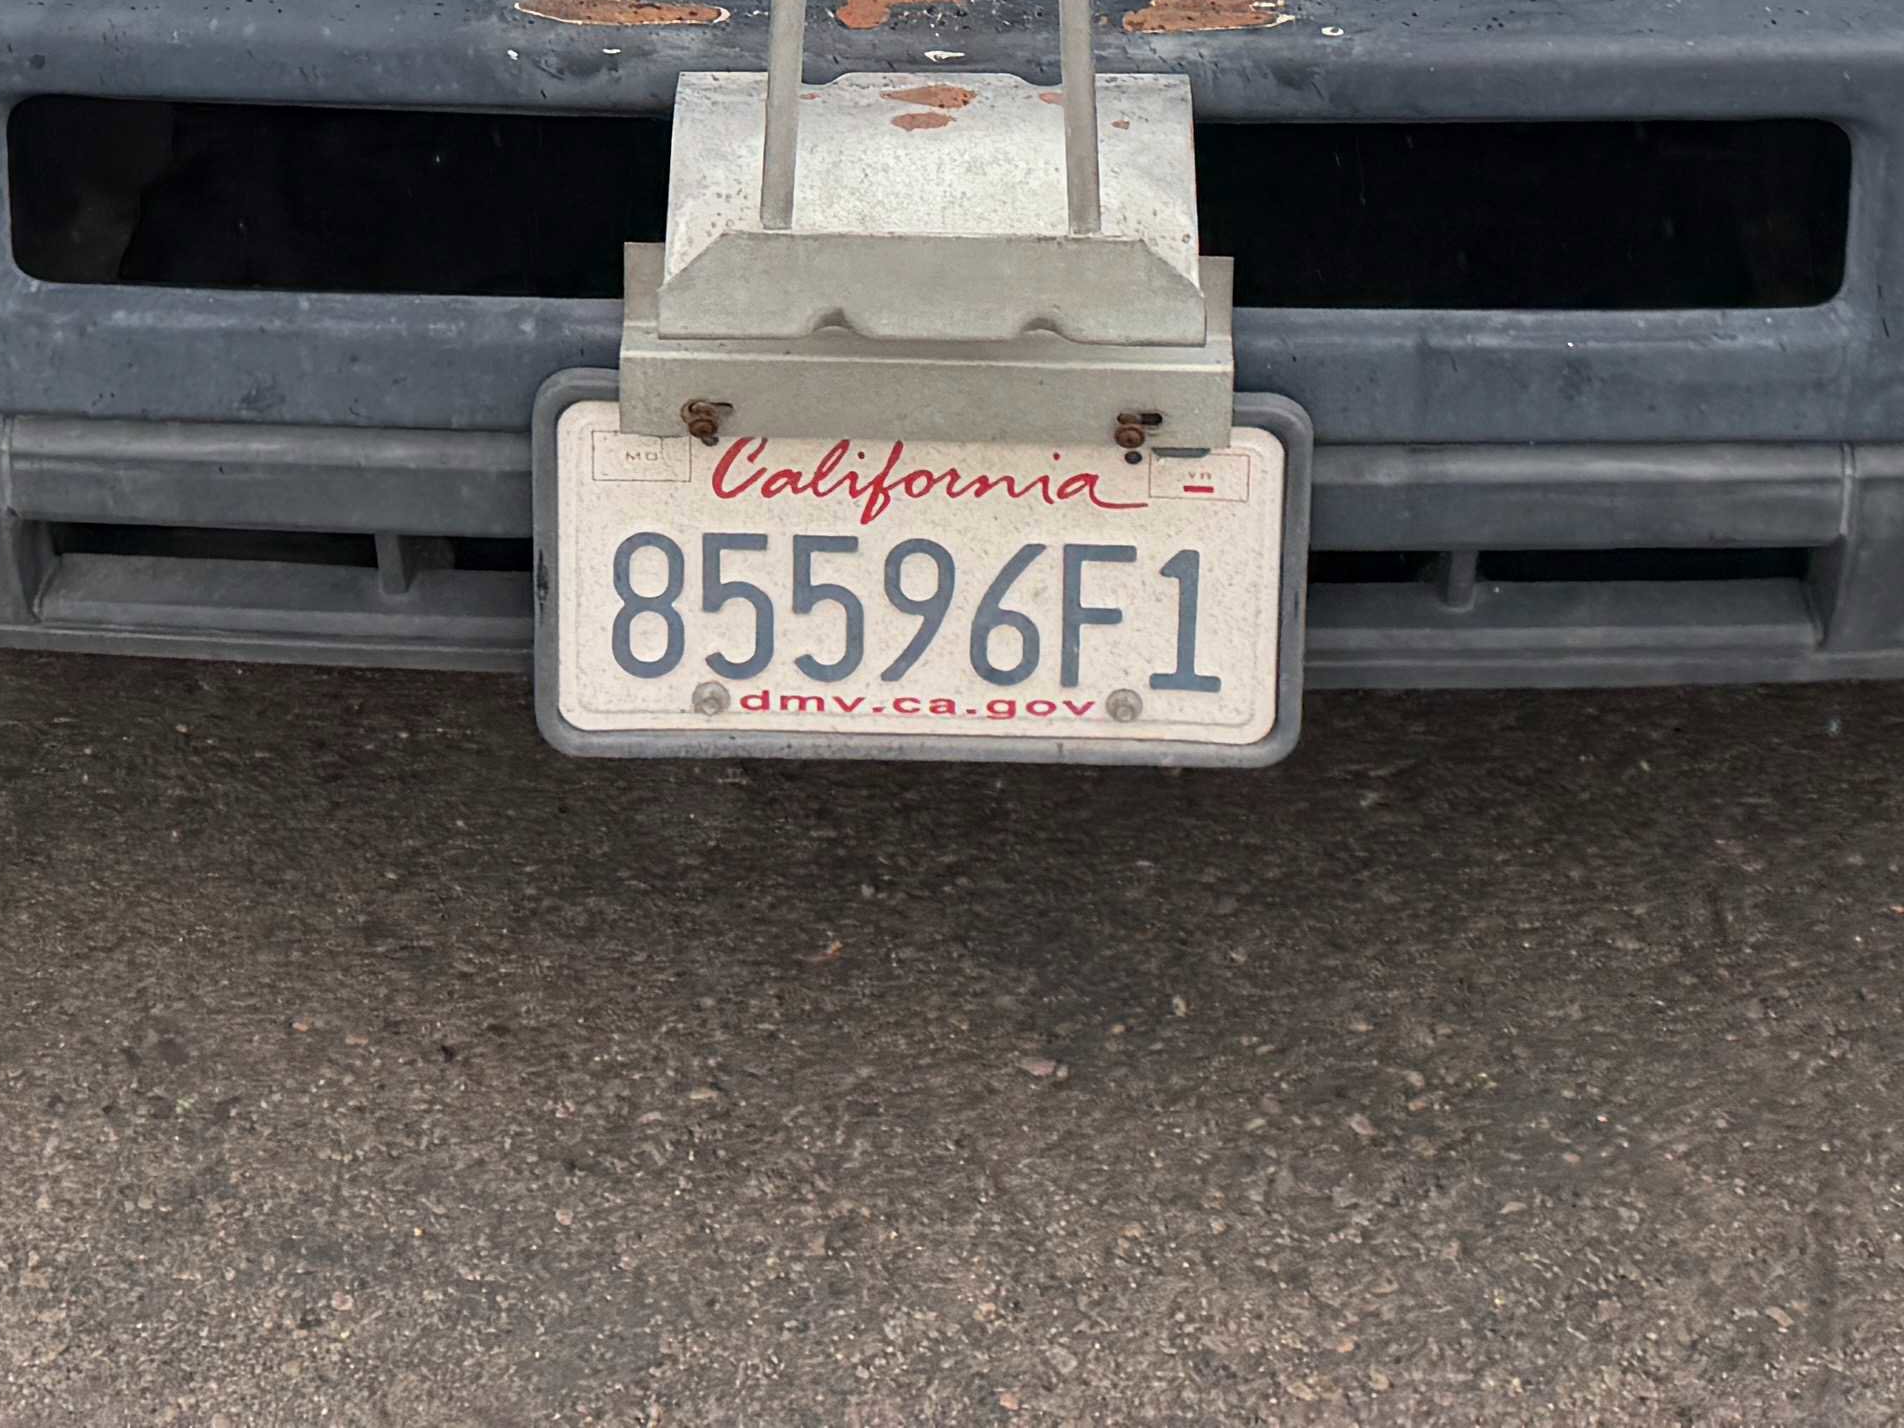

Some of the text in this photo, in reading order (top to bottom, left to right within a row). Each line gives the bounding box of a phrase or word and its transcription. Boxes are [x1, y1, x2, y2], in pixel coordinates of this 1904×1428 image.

[711, 436, 1149, 525] California
[611, 531, 1222, 693] 85596F1
[739, 689, 1096, 720] dmv.ca.gov
